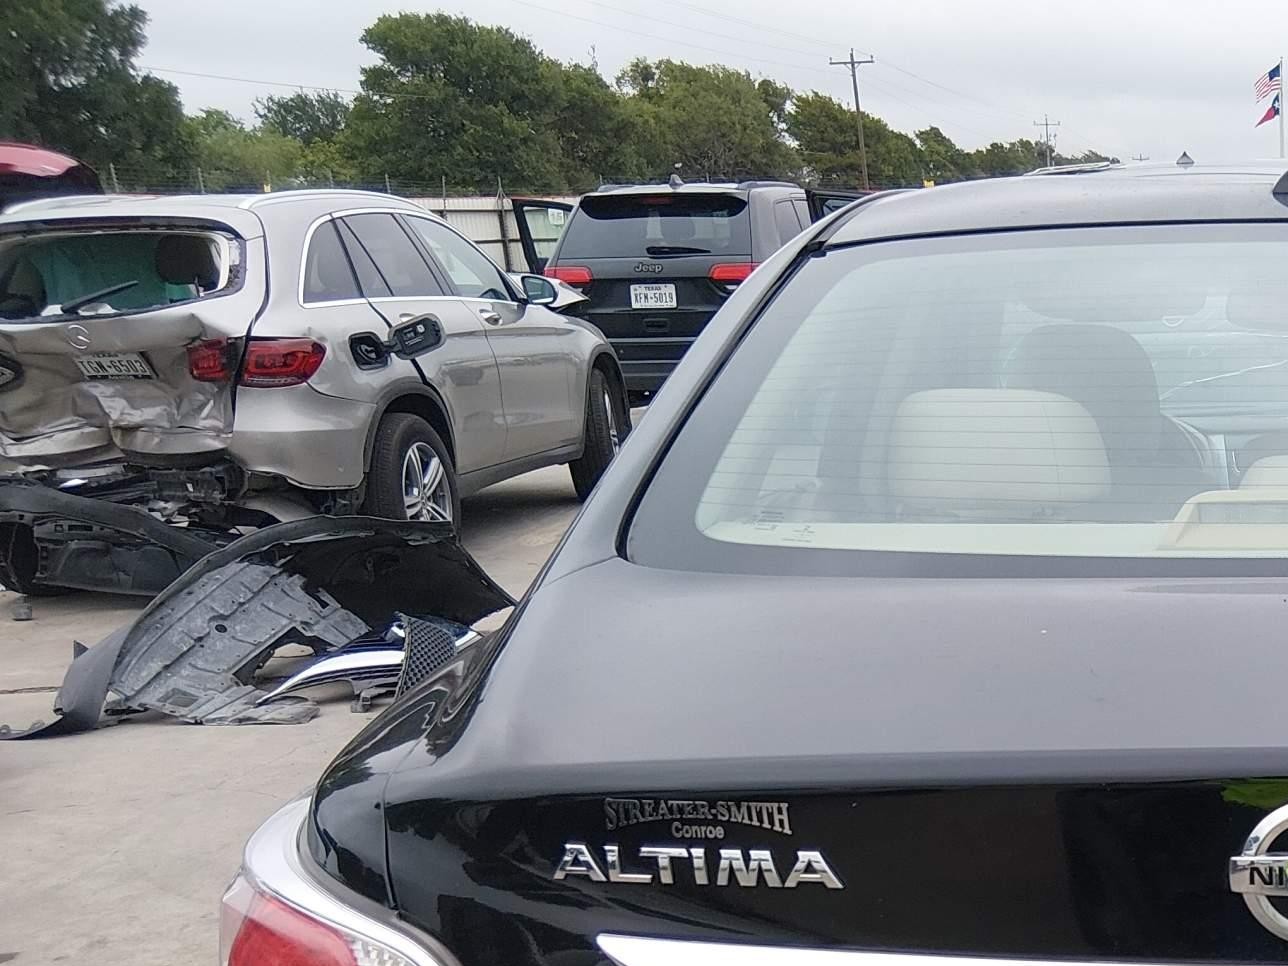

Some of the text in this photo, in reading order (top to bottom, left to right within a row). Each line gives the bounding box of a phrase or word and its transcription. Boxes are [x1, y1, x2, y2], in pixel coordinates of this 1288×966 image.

[634, 262, 663, 274] Jeep
[604, 798, 793, 835] STREATER-SMITH
[671, 821, 725, 840] Conroe
[553, 843, 845, 889] ALTIMA
